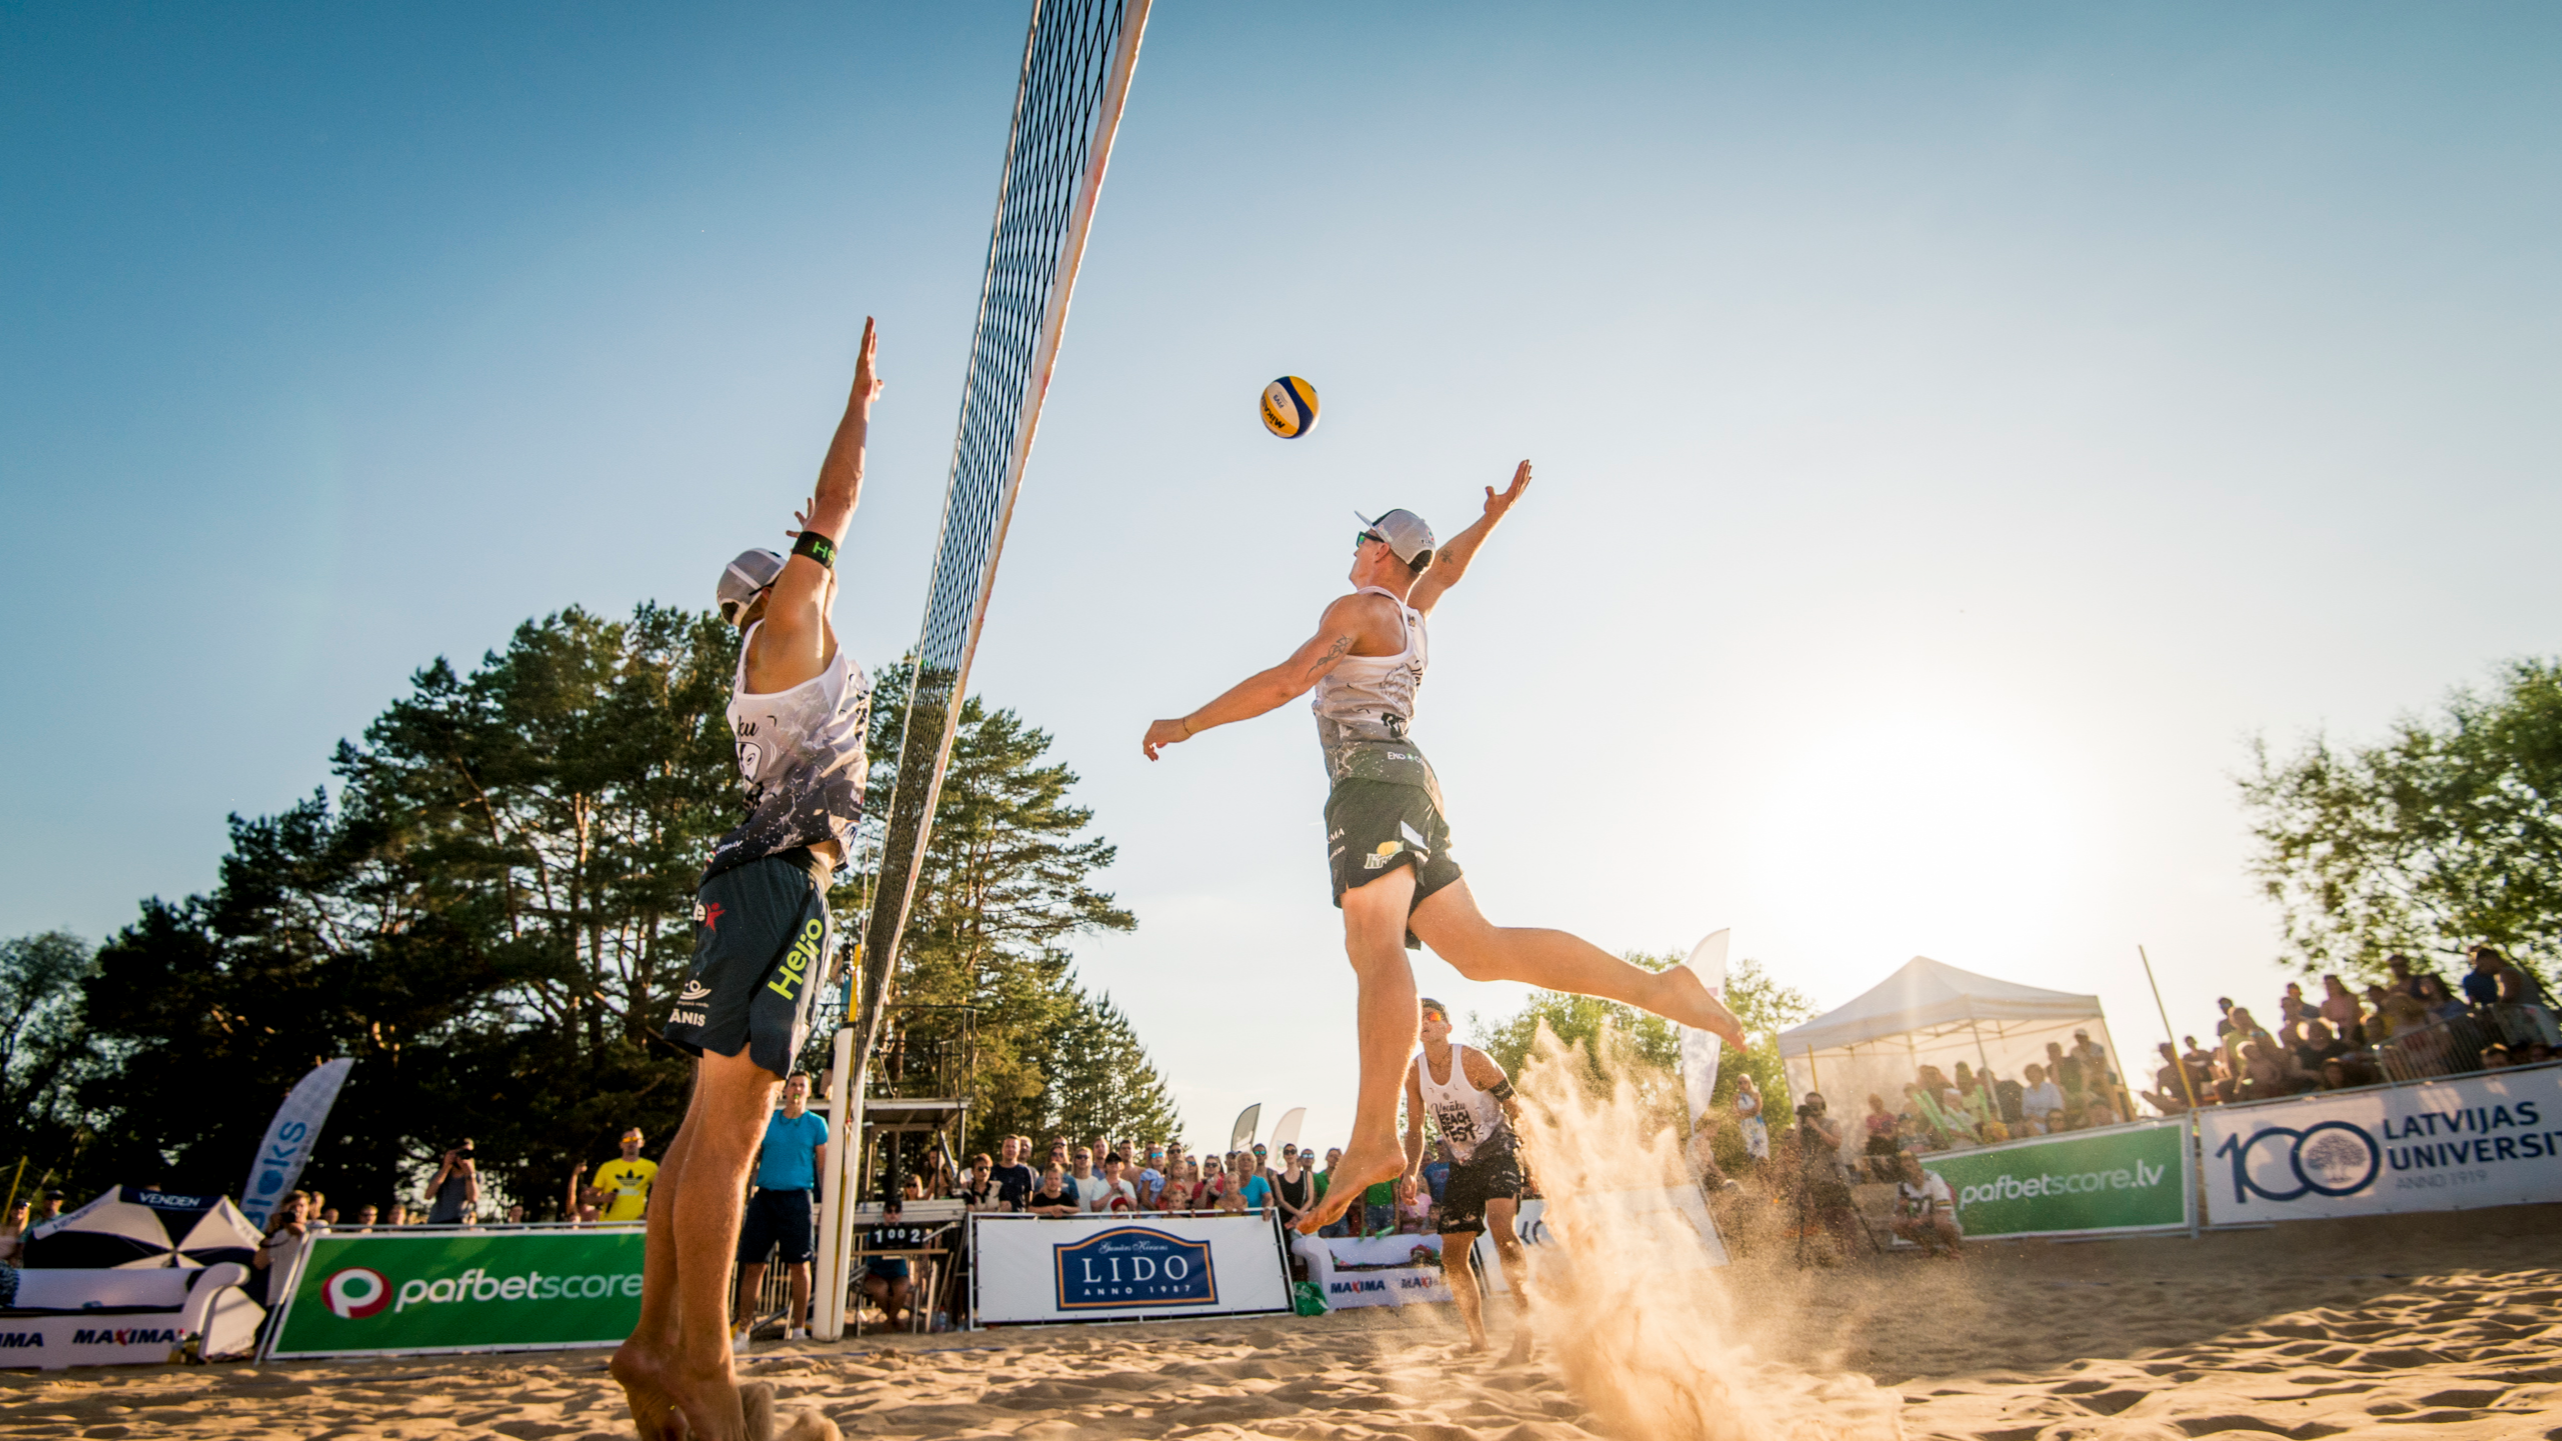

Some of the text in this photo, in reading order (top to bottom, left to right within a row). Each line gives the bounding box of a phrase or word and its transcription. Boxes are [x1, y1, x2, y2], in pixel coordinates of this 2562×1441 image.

[2384, 1101, 2541, 1140] LATVIJAS
[1958, 1158, 2165, 1211] pafbetscore.lv
[138, 1192, 201, 1207] VENDEN
[1082, 1255, 1188, 1283] LIDO
[394, 1269, 644, 1314] pafbetscore
[1084, 1285, 1191, 1296] ANNO 1987
[1330, 1280, 1385, 1294] MAXIMA
[72, 1328, 176, 1346] MAXIMA
